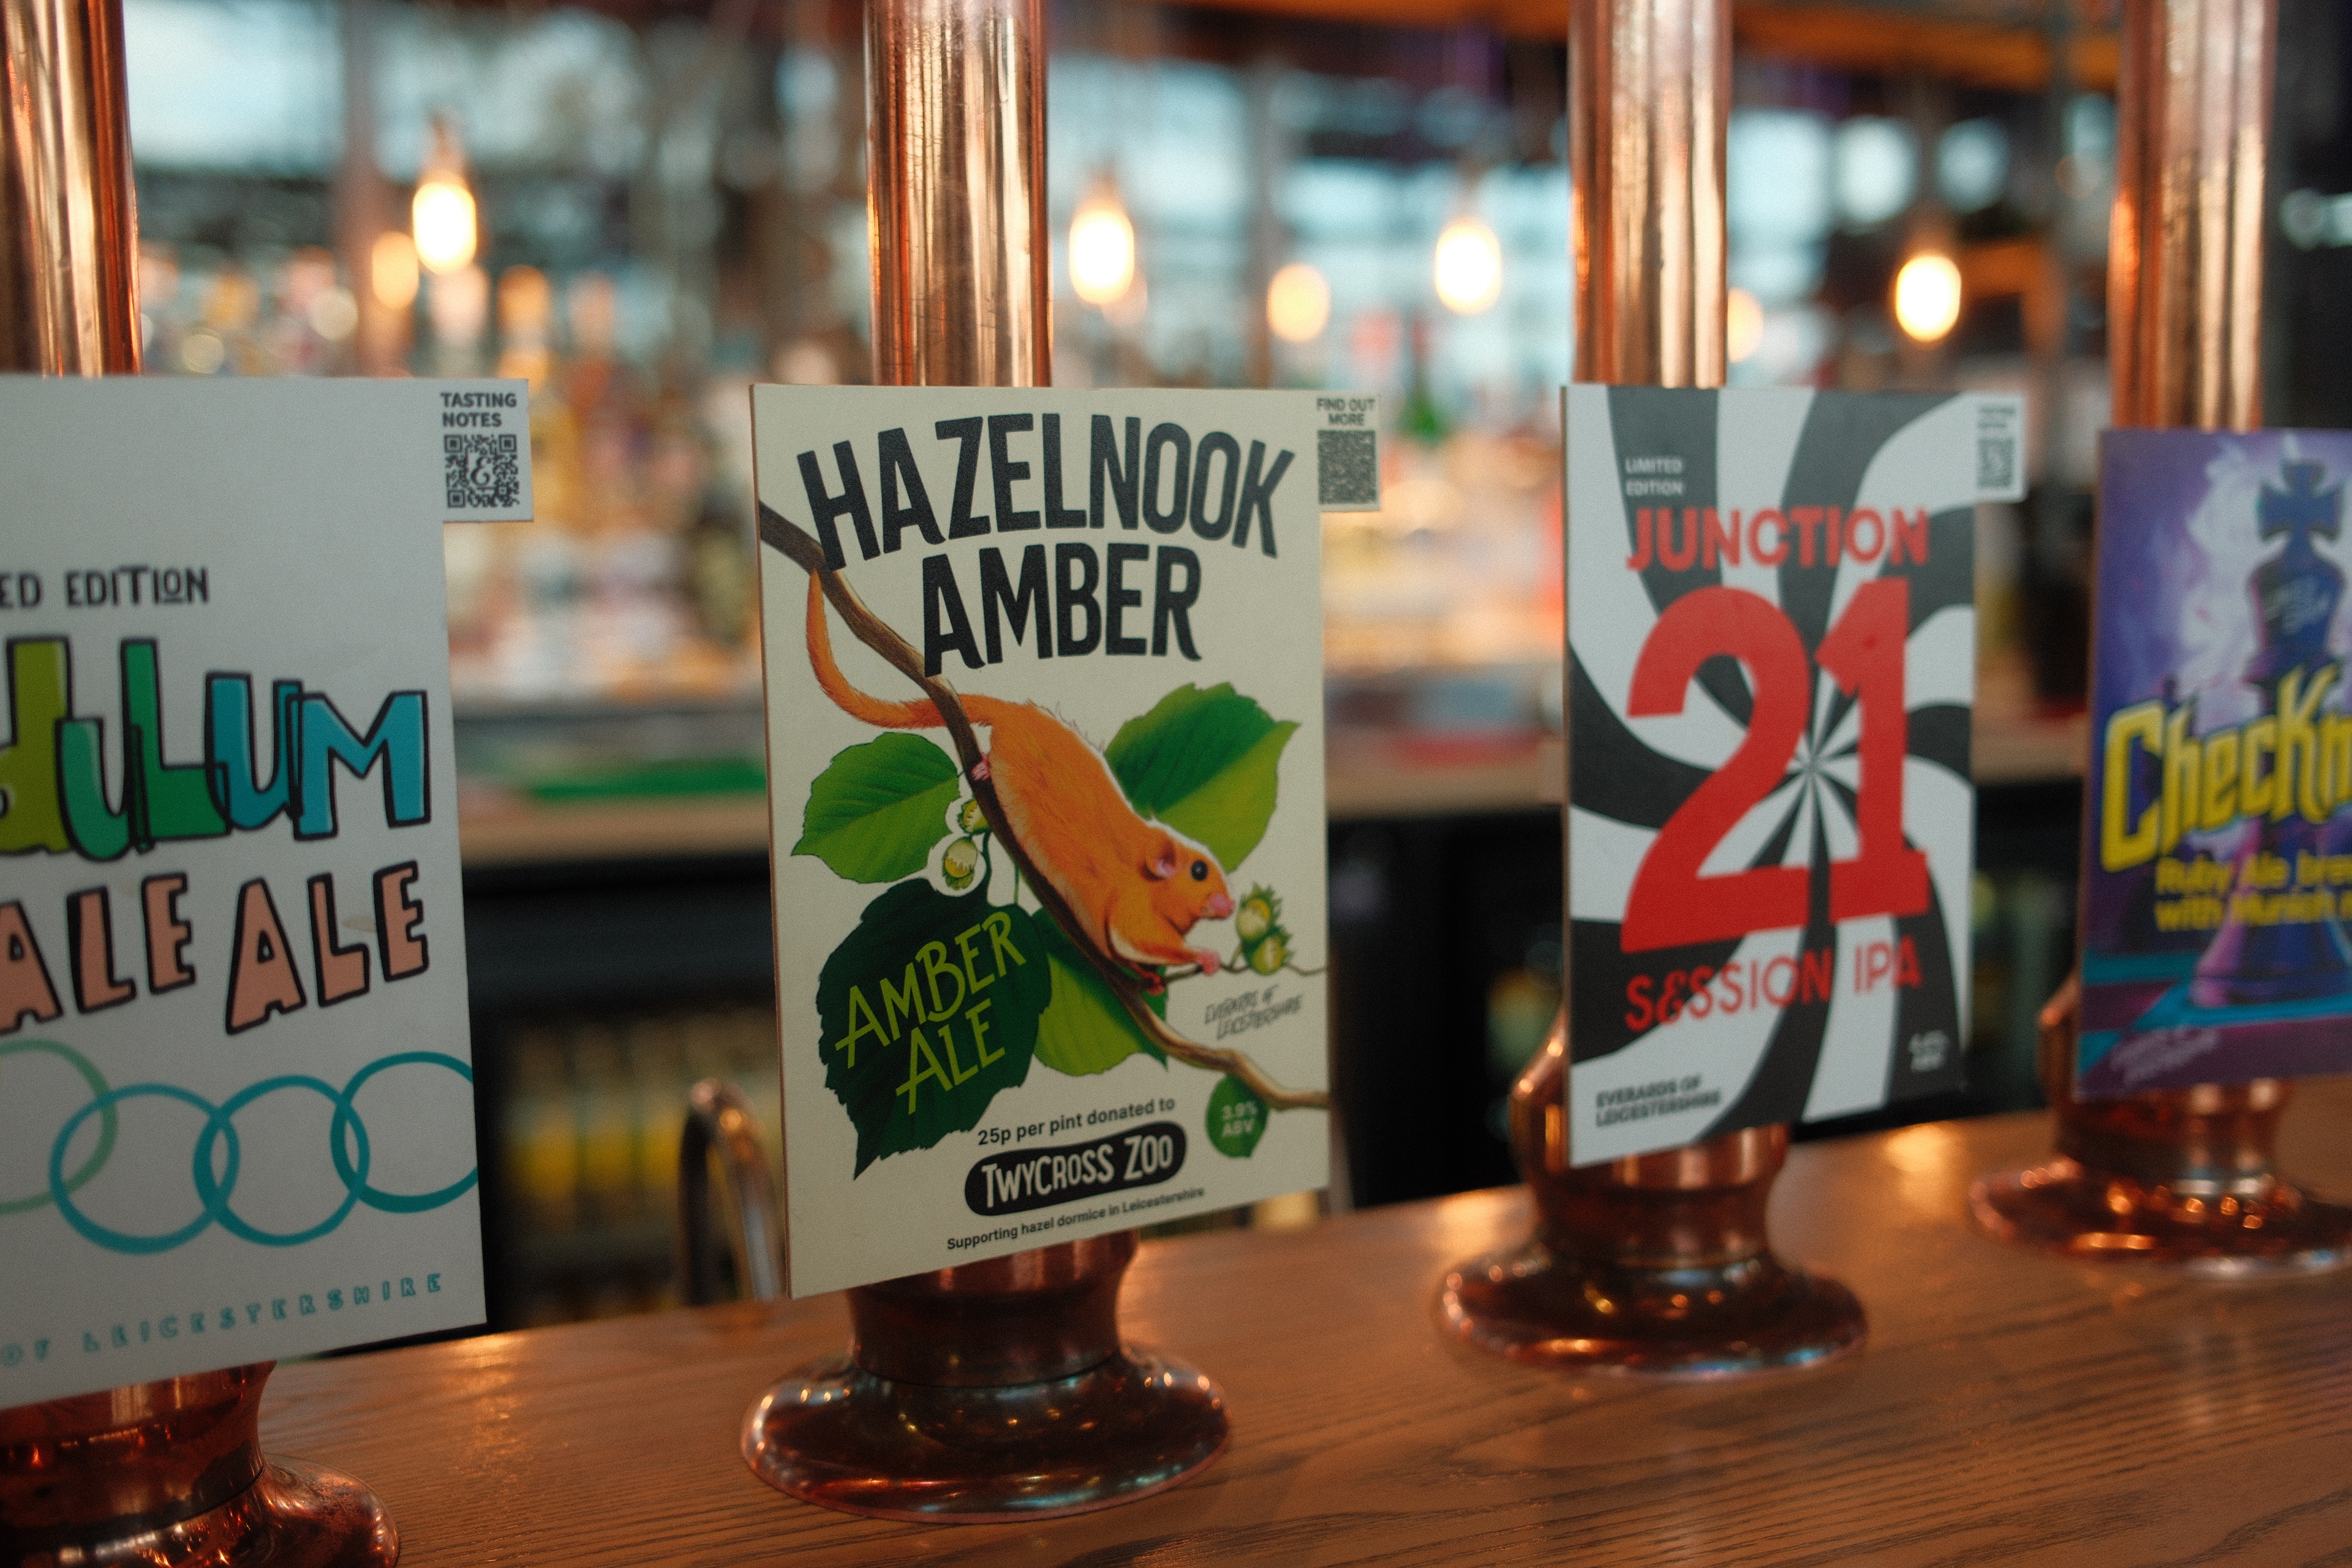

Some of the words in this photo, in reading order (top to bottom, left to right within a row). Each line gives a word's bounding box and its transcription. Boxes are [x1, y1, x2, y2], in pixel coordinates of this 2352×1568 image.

[440, 393, 518, 408] TASTING
[442, 412, 502, 428] NOTES
[1317, 398, 1346, 411] FIND
[1348, 398, 1376, 412] OUT
[1328, 413, 1365, 425] MORE
[796, 413, 1295, 571] HAZELNOOK
[1626, 505, 1929, 571] JUNCTION
[65, 564, 209, 608] EDITION
[922, 542, 1202, 677] AMBER
[1620, 576, 1929, 954] 21
[224, 859, 430, 1036] ALE
[1853, 934, 1923, 997] IPA
[834, 911, 1027, 1069] AMBER
[895, 998, 1006, 1116] ALE
[978, 1127, 1012, 1145] 25p
[1016, 1121, 1045, 1142] per
[1049, 1114, 1082, 1136] pint
[1087, 1099, 1155, 1126] donated
[1159, 1098, 1175, 1112] to
[947, 1227, 1018, 1250] Supporting
[1021, 1218, 1055, 1236] hazel
[1057, 1208, 1105, 1227] dormice
[1108, 1204, 1120, 1216] in
[1122, 1186, 1205, 1213] Leicestershire
[84, 1273, 442, 1354] LEICESTERSHIRE
